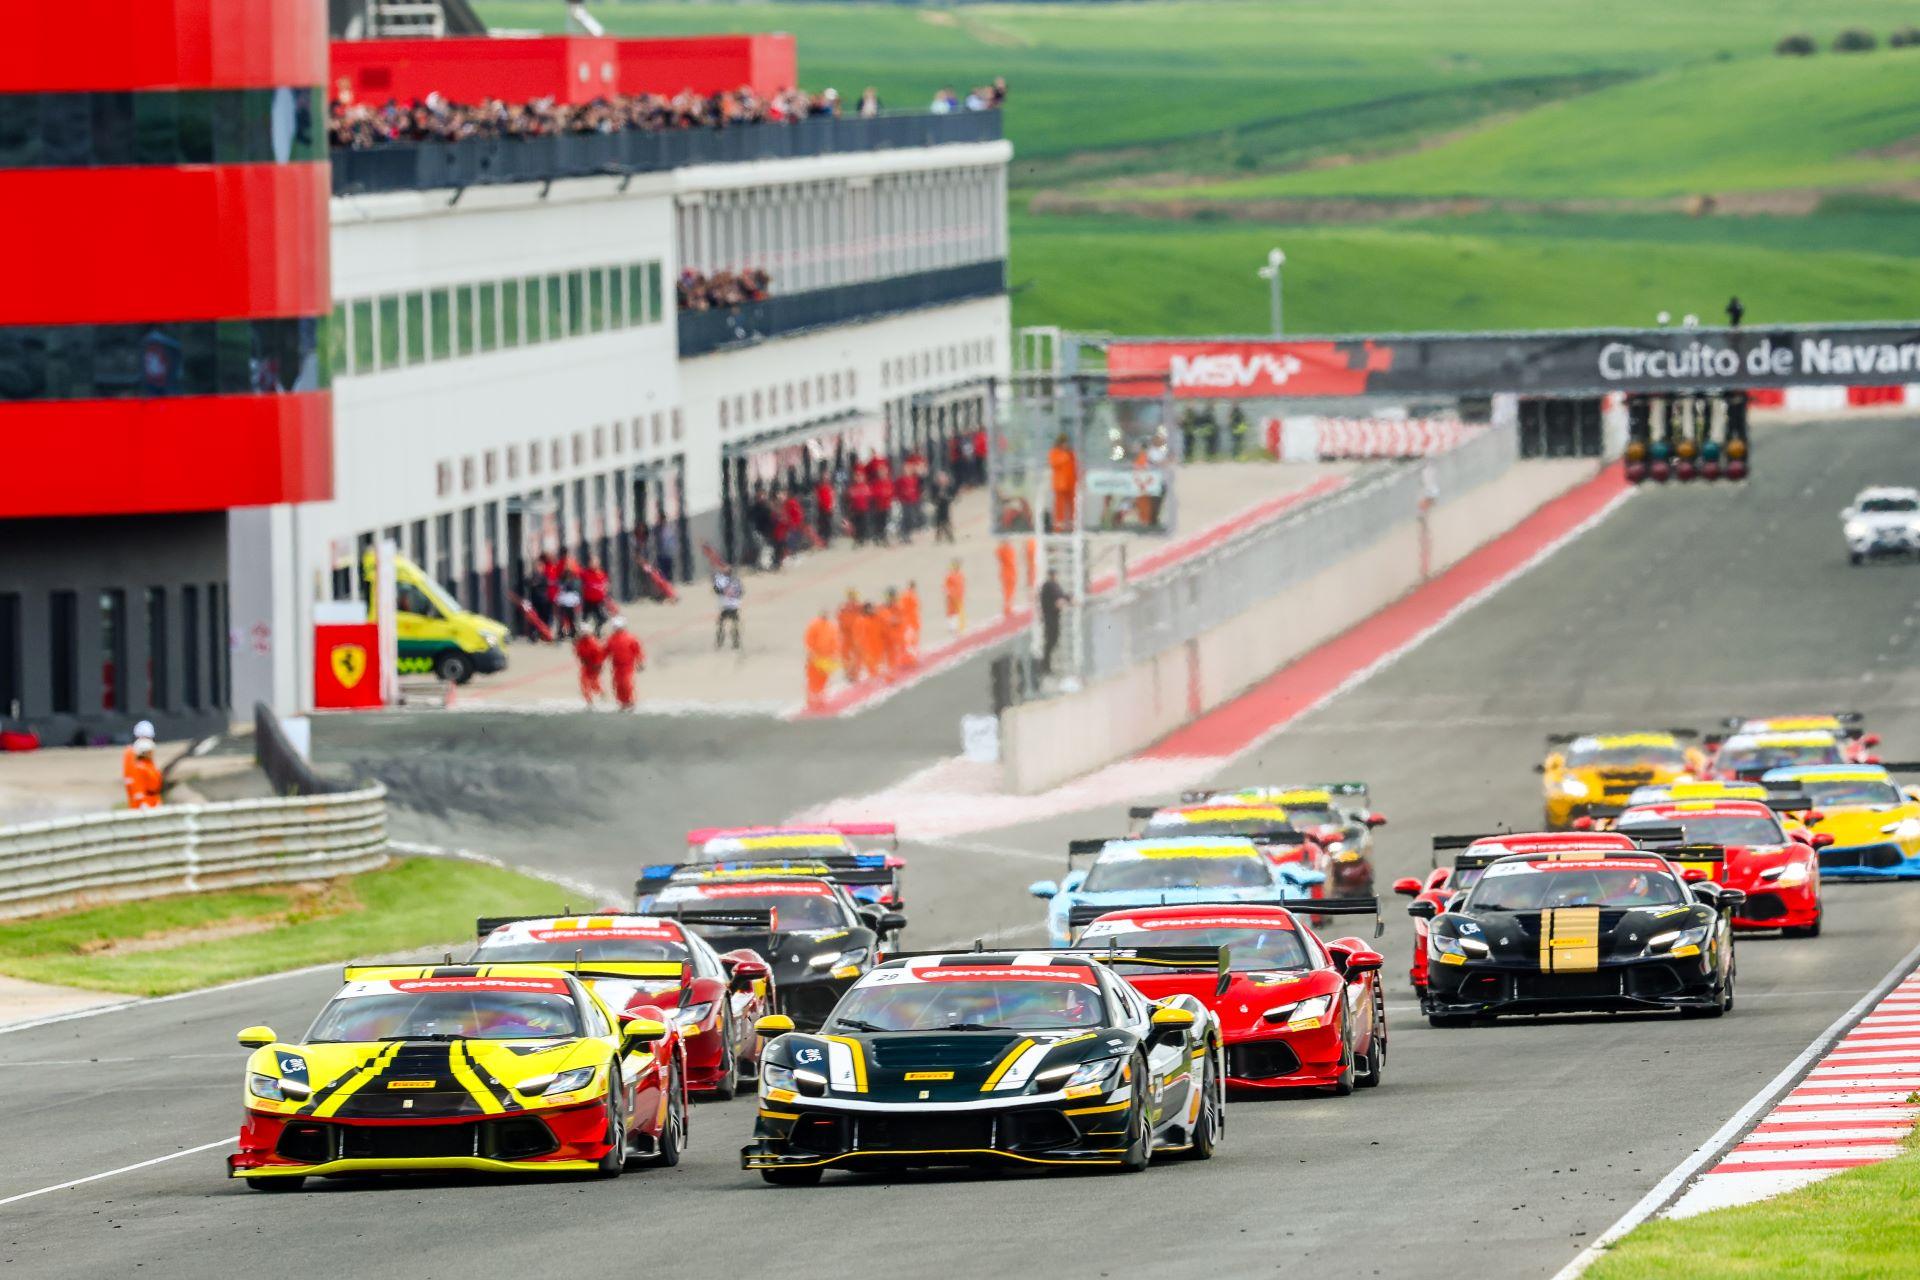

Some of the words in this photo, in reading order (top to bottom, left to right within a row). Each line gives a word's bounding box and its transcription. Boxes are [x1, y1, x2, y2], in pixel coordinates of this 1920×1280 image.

[1598, 341, 1740, 380] Circuito
[1746, 338, 1794, 376] de
[1142, 917, 1281, 928] @FerrariRaces
[875, 973, 900, 982] 29
[921, 968, 1081, 980] @FerrariRaces
[400, 979, 554, 990] @FerrariRaces
